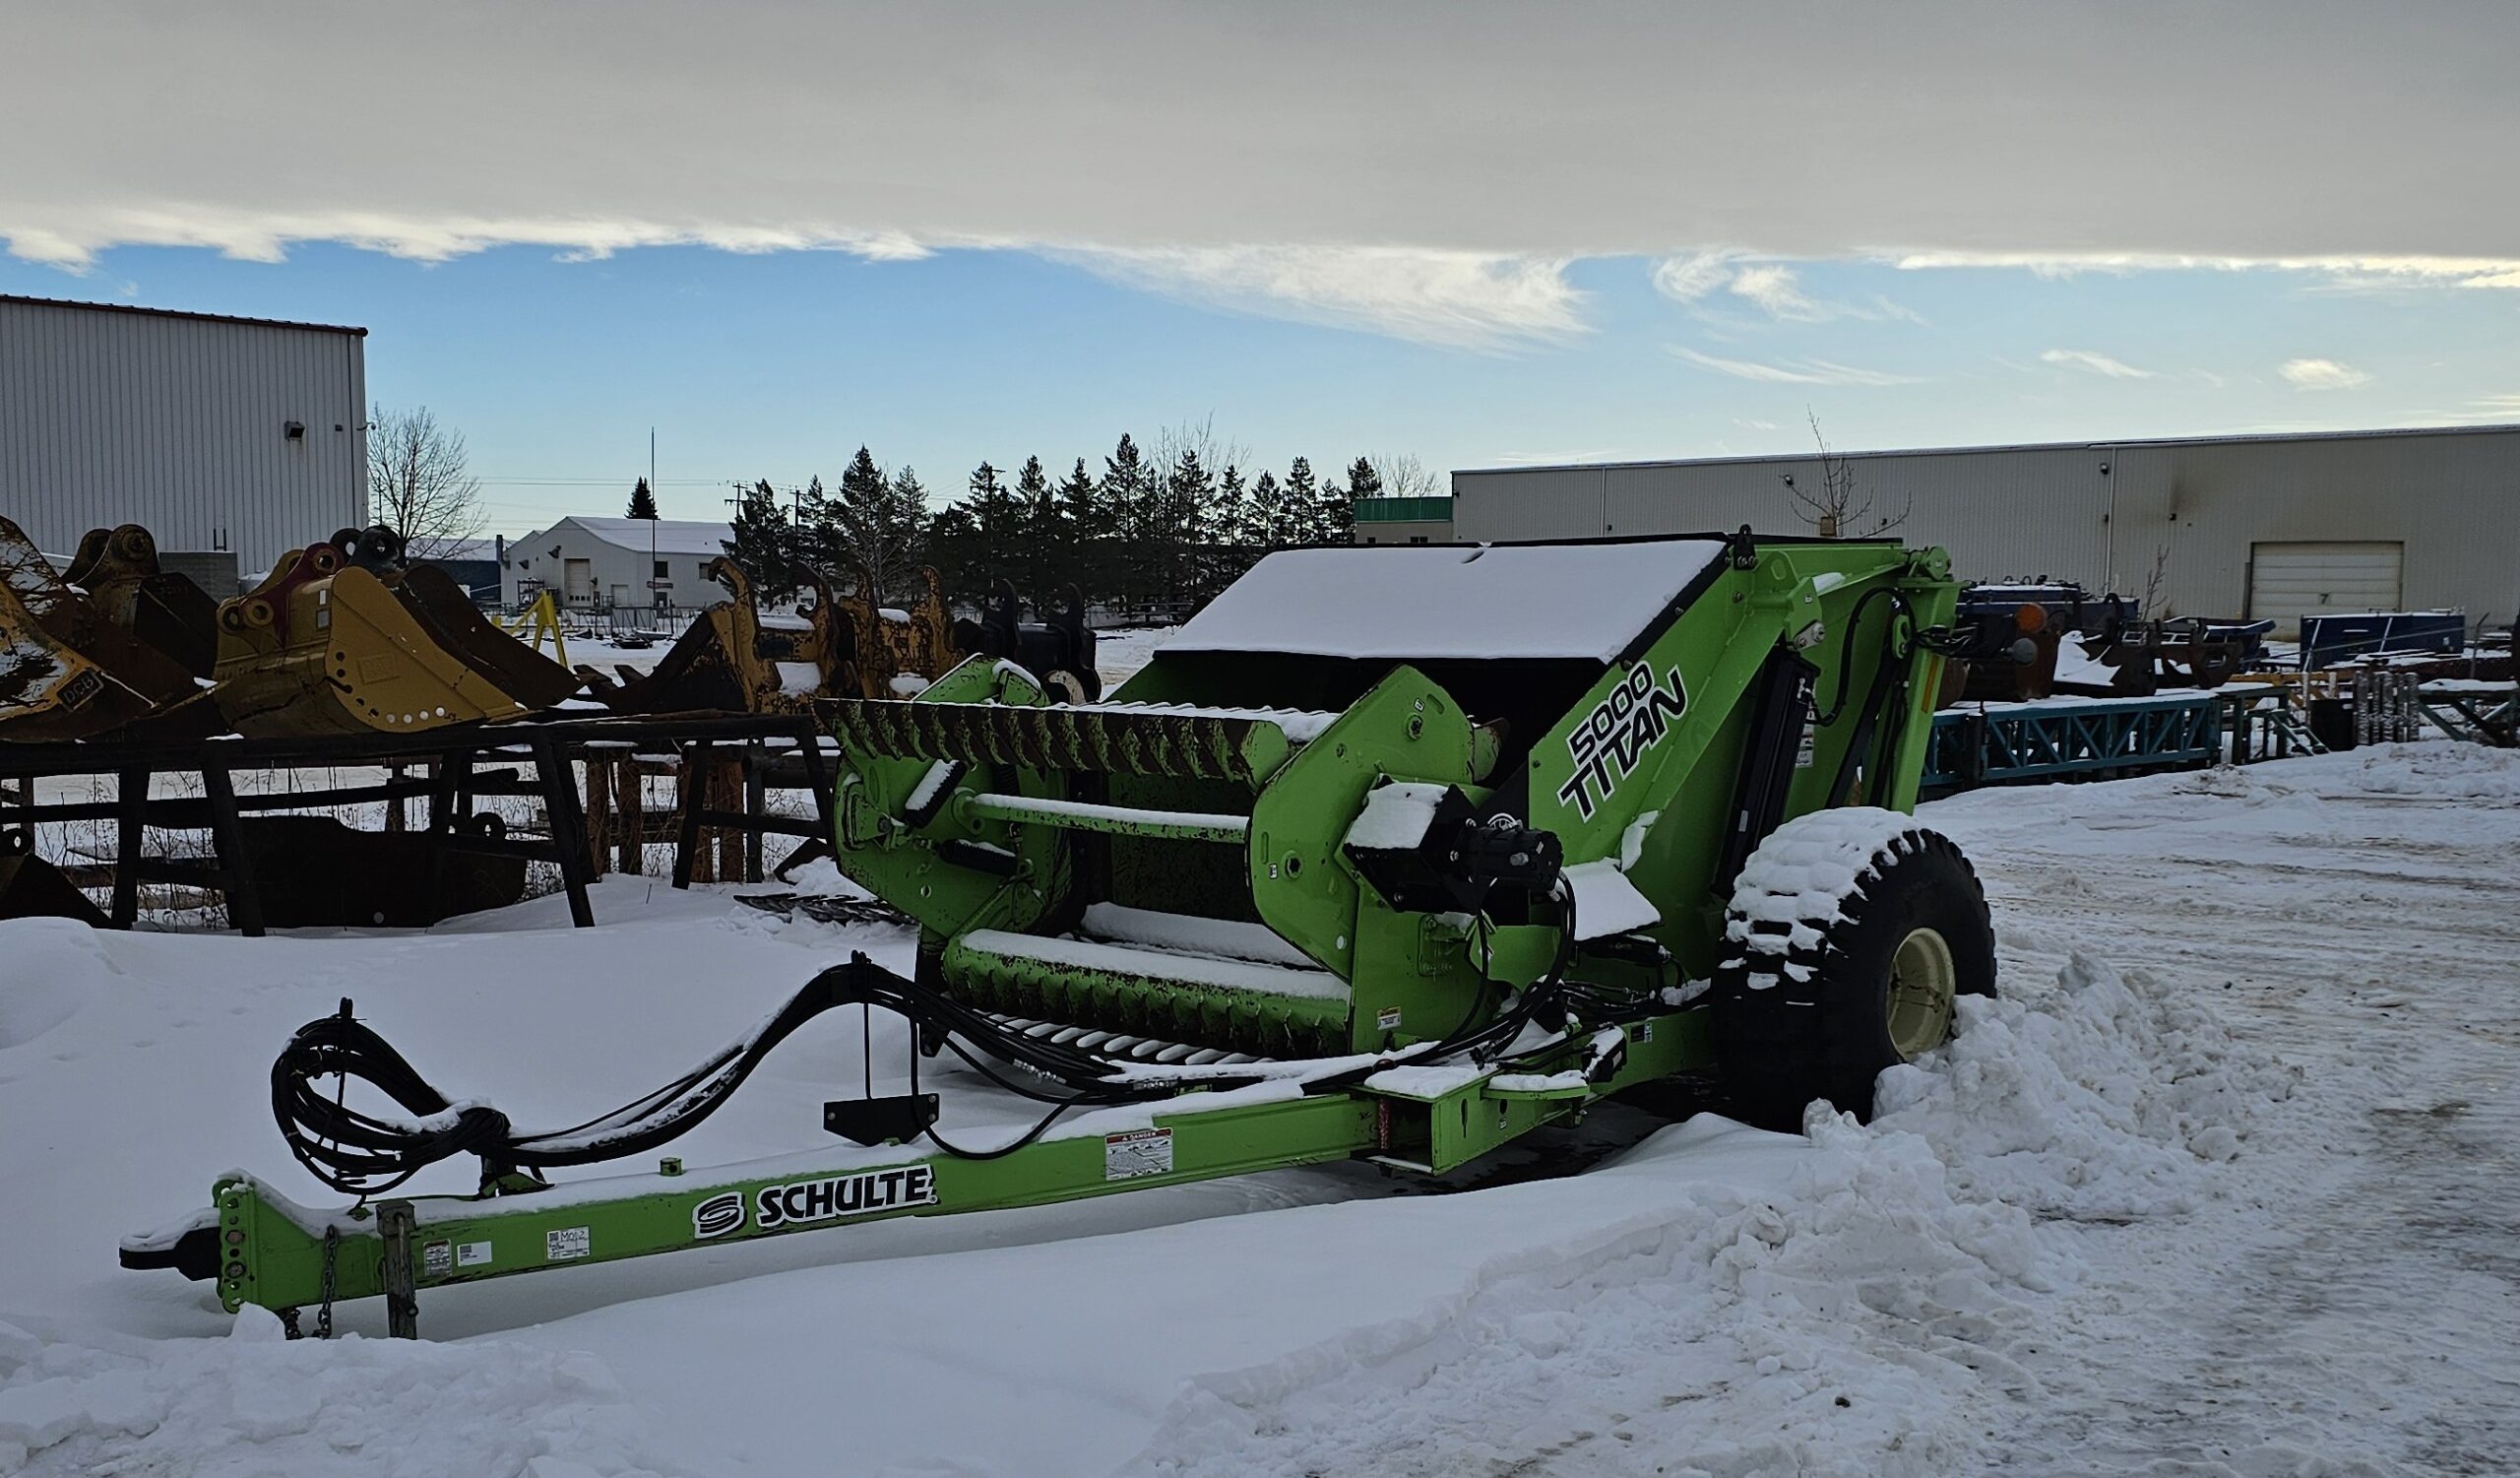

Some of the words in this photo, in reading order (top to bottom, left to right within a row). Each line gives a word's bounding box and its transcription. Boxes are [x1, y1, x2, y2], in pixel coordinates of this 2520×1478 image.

[2319, 593, 2330, 606] 7
[1568, 662, 1653, 767] 5000
[1558, 669, 1686, 818] TITAN
[1129, 1131, 1158, 1141] DANGER
[758, 1168, 929, 1225] SCHULTE
